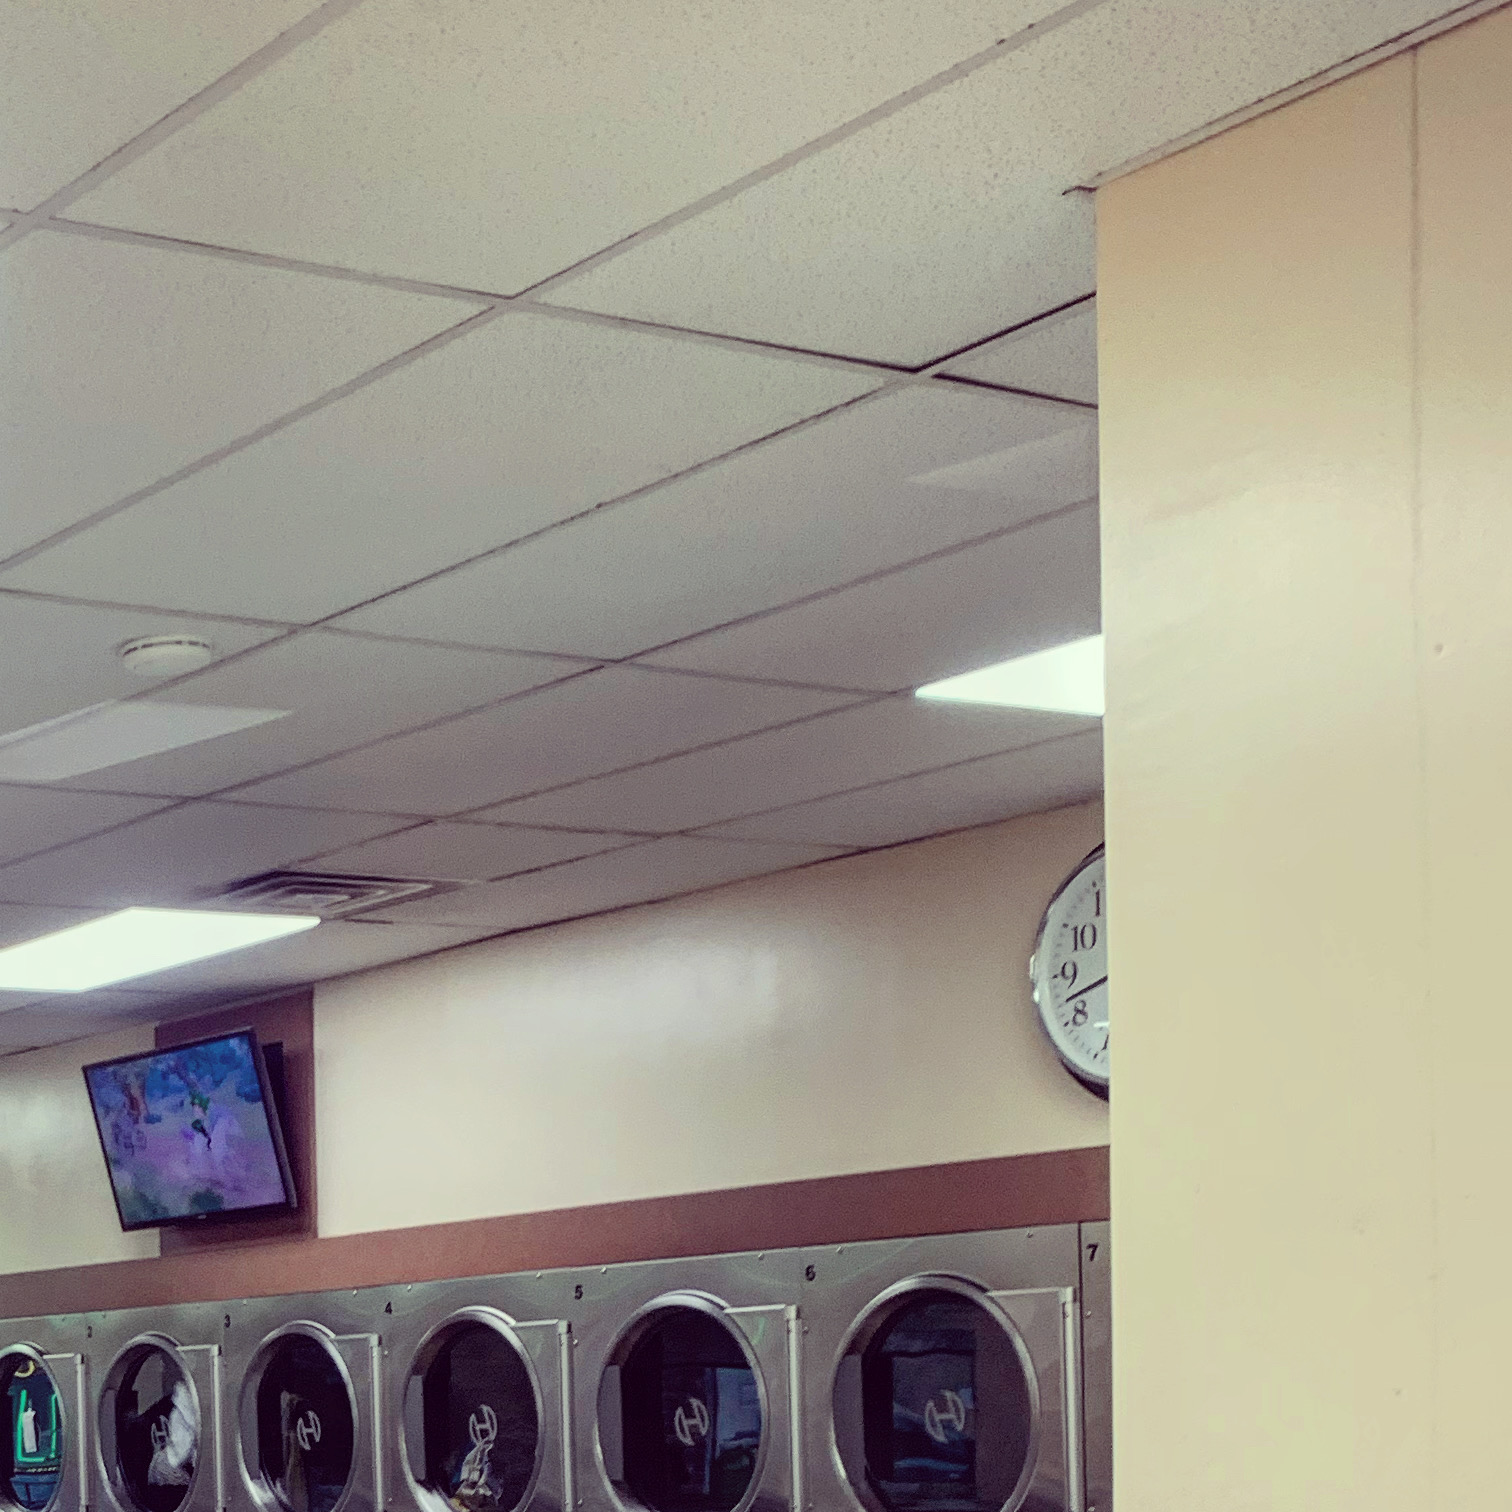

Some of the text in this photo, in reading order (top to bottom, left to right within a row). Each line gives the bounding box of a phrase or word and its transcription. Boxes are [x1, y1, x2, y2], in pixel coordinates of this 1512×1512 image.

[1072, 922, 1097, 952] 10
[1061, 960, 1078, 989] 9
[1072, 1000, 1088, 1027] 8
[1086, 1243, 1098, 1261] 7
[805, 1265, 816, 1281] 6
[574, 1284, 583, 1300] 5
[384, 1301, 393, 1314] 4
[224, 1314, 231, 1328] 3
